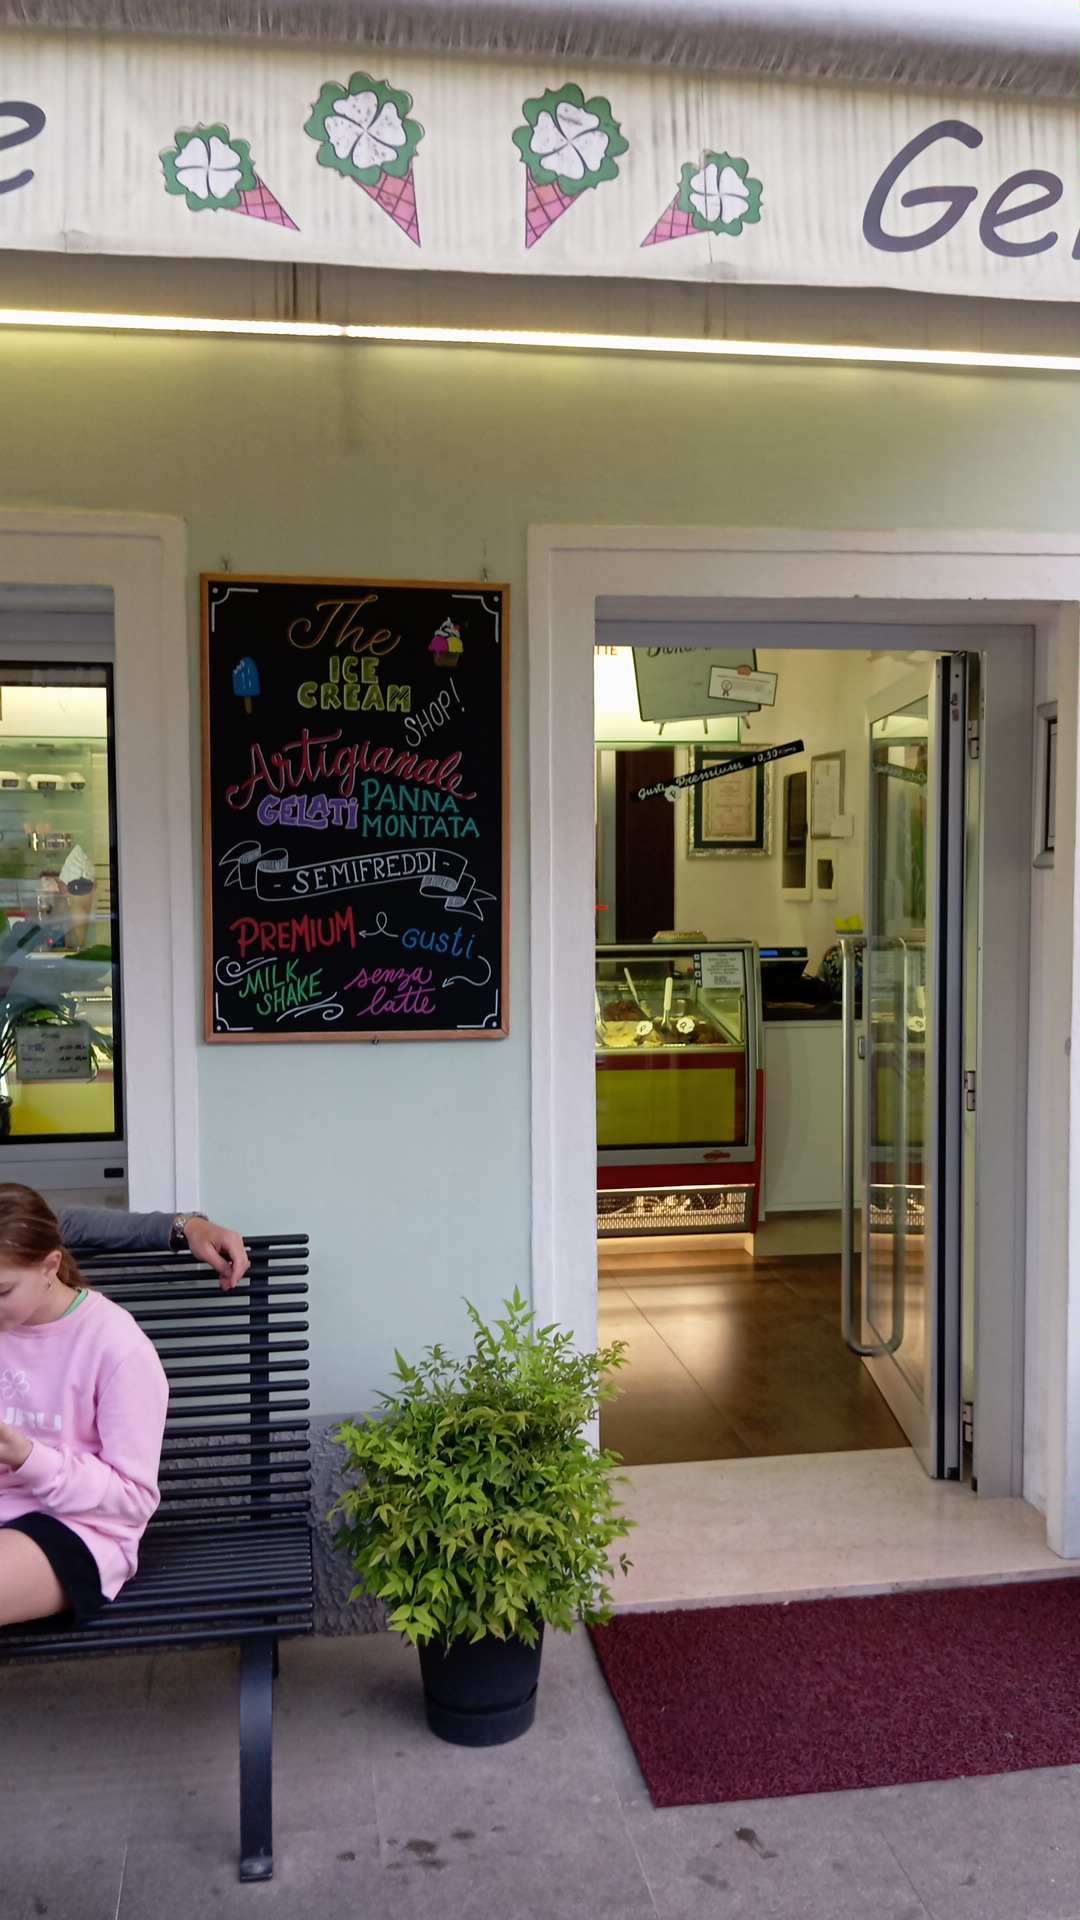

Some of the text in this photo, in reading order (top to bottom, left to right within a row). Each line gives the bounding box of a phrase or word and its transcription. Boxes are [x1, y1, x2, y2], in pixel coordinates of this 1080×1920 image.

[863, 120, 1080, 260] Ge
[287, 594, 401, 655] The
[329, 656, 380, 684] ICE
[297, 681, 411, 712] CREAM
[404, 677, 465, 747] SHOP!
[225, 728, 477, 810] Artigianale
[676, 762, 743, 787] Premium
[361, 778, 460, 813] PANNA
[361, 814, 480, 838] MONTATA
[229, 906, 357, 958] PREMIUM
[239, 959, 300, 999] MILK
[256, 968, 323, 1016] SHAKE
[344, 966, 432, 991] senza
[357, 988, 436, 1016] latte
